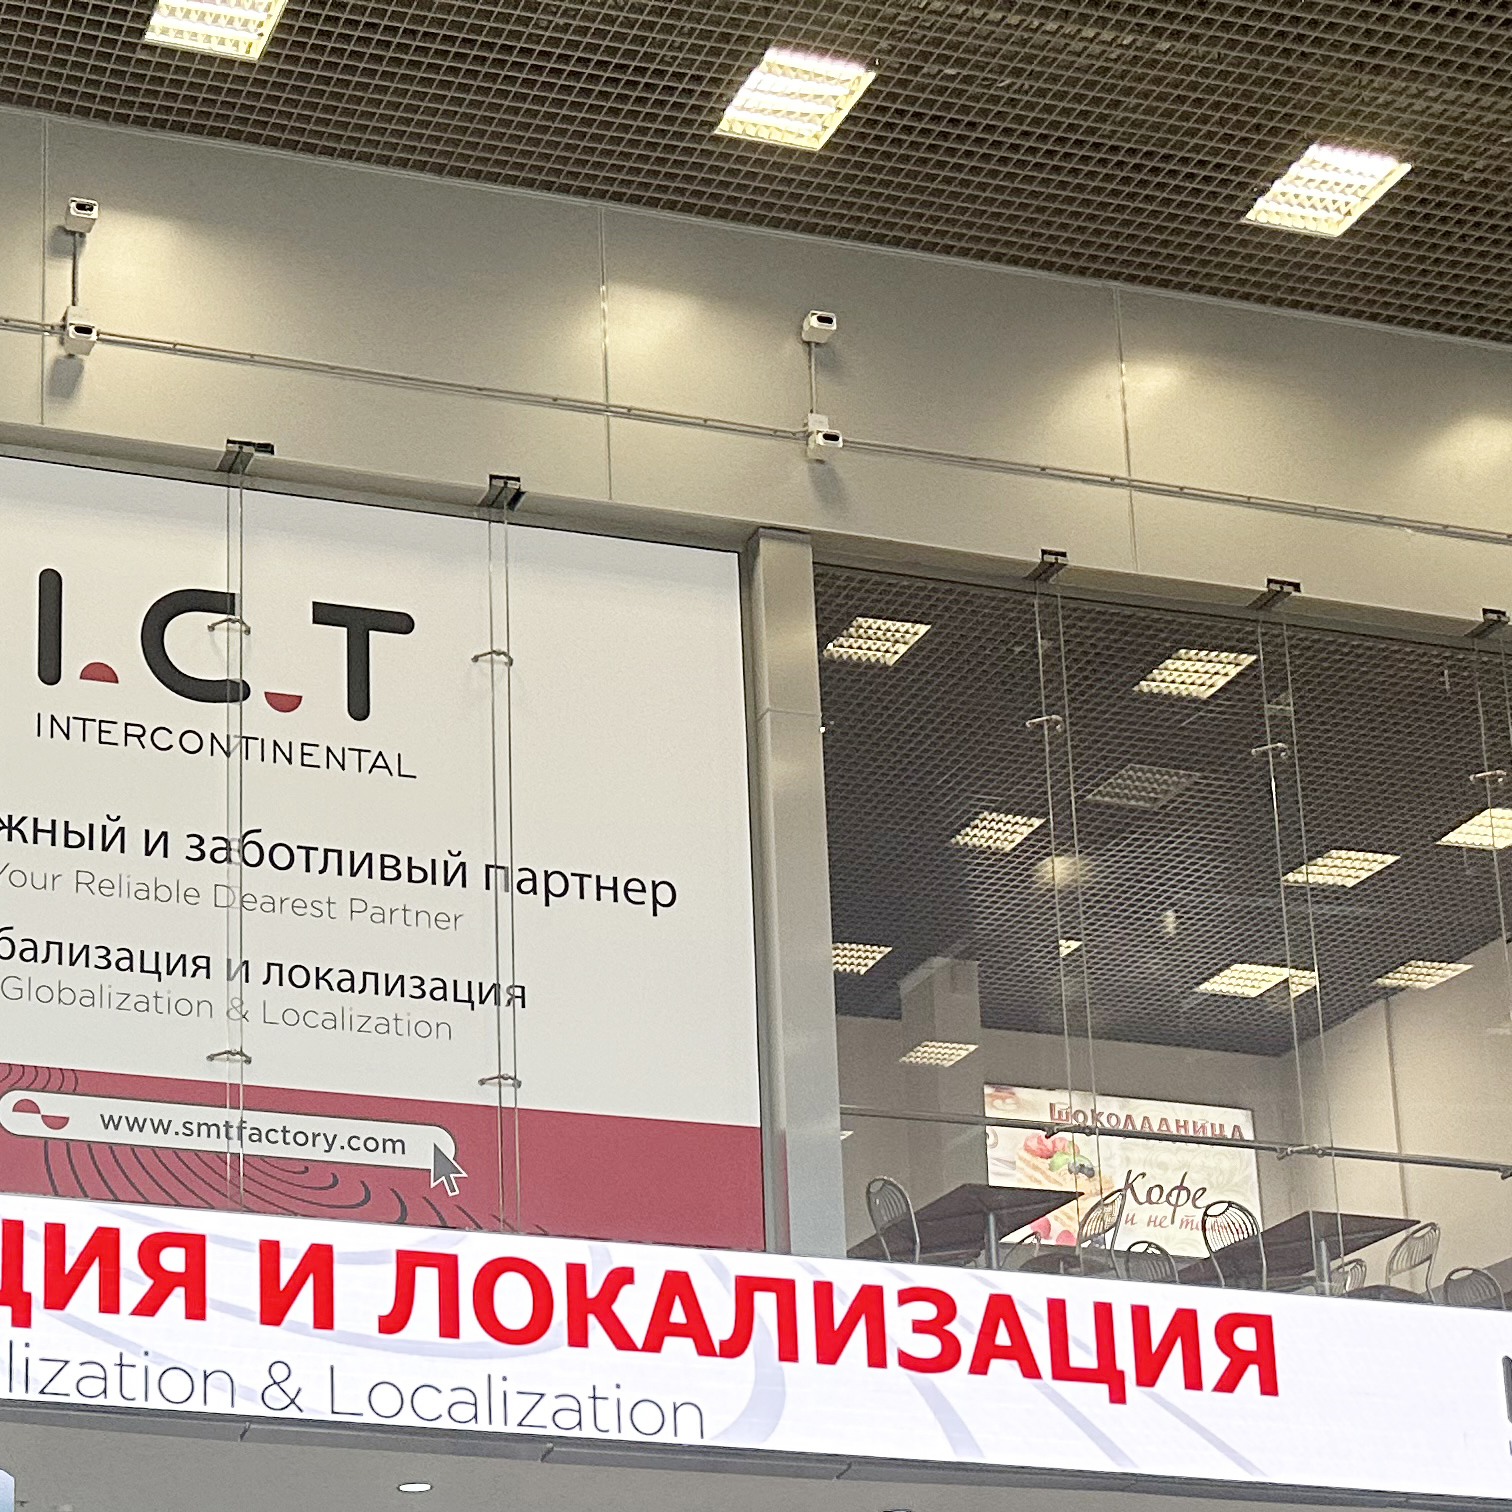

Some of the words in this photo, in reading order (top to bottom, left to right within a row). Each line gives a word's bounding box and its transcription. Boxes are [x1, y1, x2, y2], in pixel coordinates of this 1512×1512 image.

[37, 568, 416, 722] I.C.T
[35, 711, 418, 780] INTERCONTINENTAL
[73, 866, 202, 908] Reliable
[214, 883, 338, 920] Dearest
[348, 895, 464, 932] Partner
[143, 824, 171, 861] и
[184, 826, 469, 891] заботливый
[483, 854, 679, 917] партнер
[0, 974, 214, 1022] Globalization
[226, 991, 251, 1022] &
[261, 998, 453, 1043] Localization
[226, 951, 252, 983] и
[262, 955, 528, 1011] локализация
[99, 1106, 406, 1157] www.smtfactory.com
[1147, 1212, 1170, 1228] не
[258, 1239, 334, 1331] И
[378, 1251, 1280, 1405] ЛОКАЛИЗАЦИЯ
[260, 1360, 303, 1416] &
[354, 1364, 706, 1442] Localization
